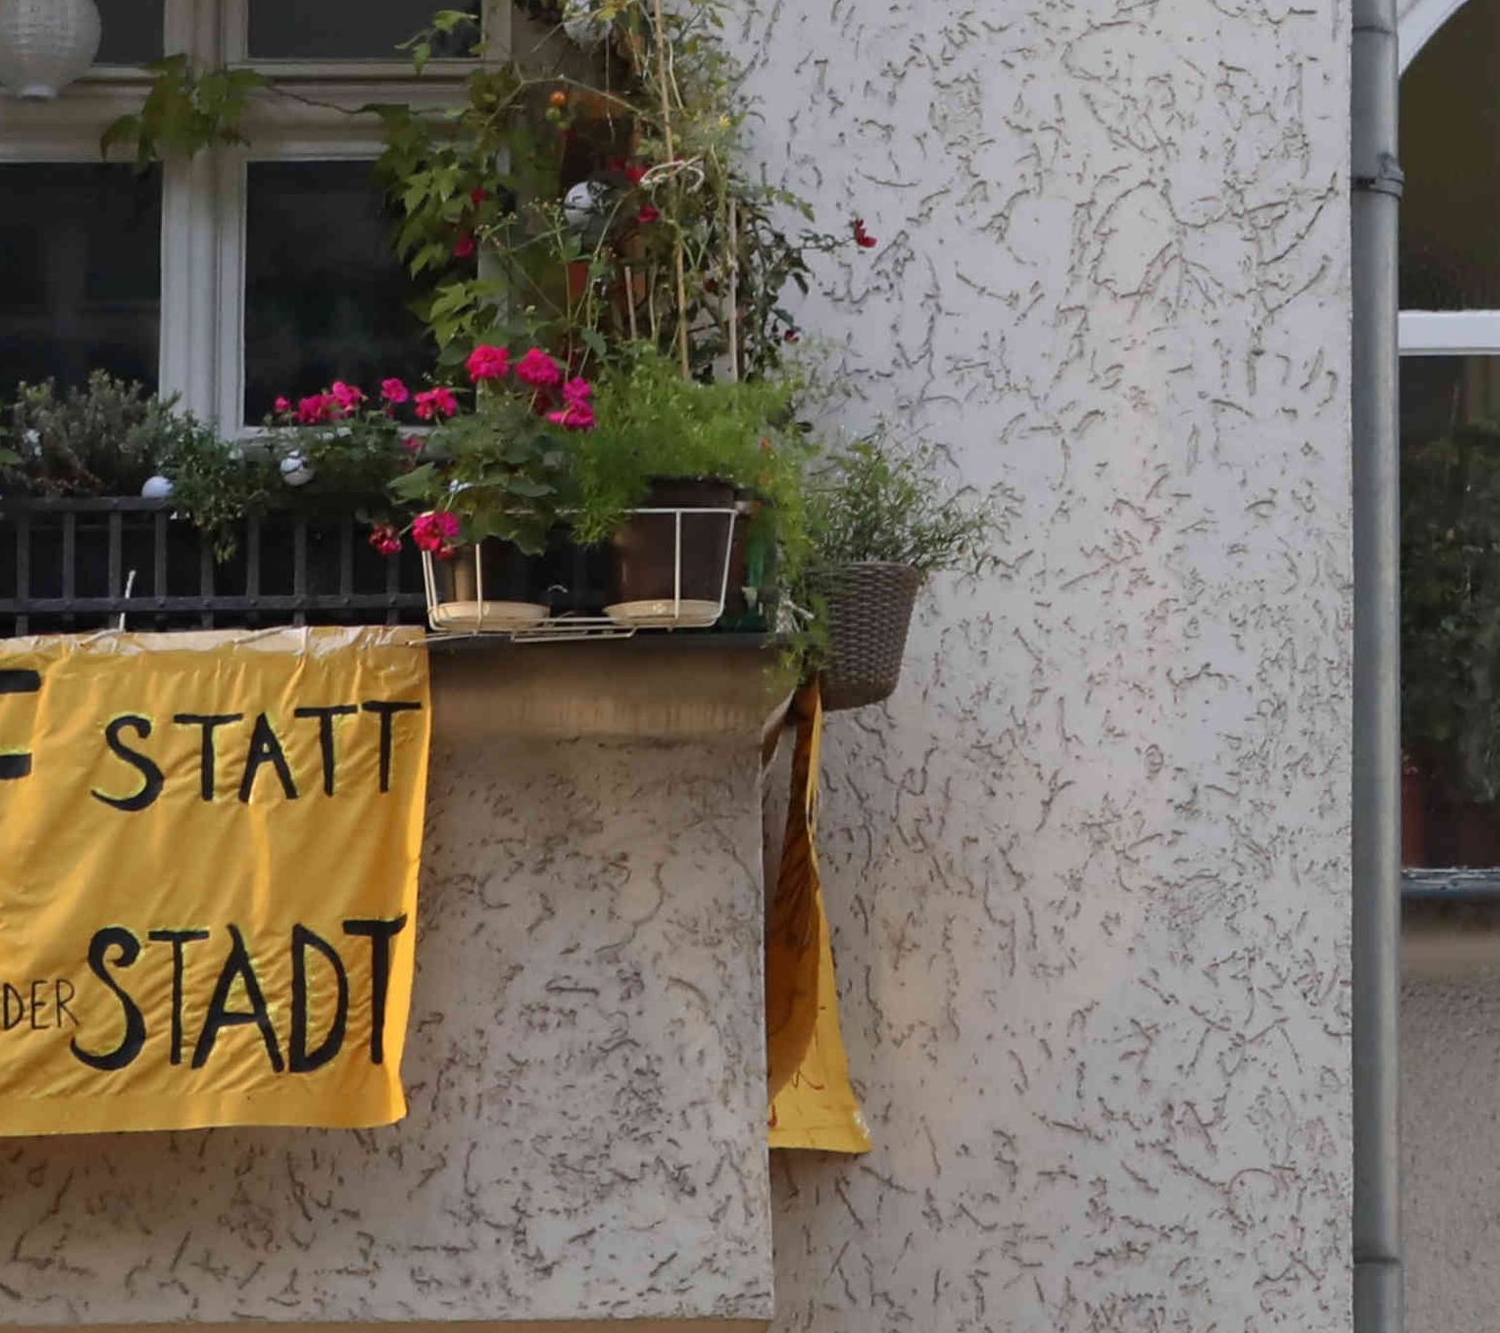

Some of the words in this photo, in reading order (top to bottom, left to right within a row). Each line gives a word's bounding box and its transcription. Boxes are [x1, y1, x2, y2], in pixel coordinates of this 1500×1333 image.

[88, 699, 422, 812] STATT
[0, 976, 81, 1033] DER
[71, 915, 408, 1074] STADT
